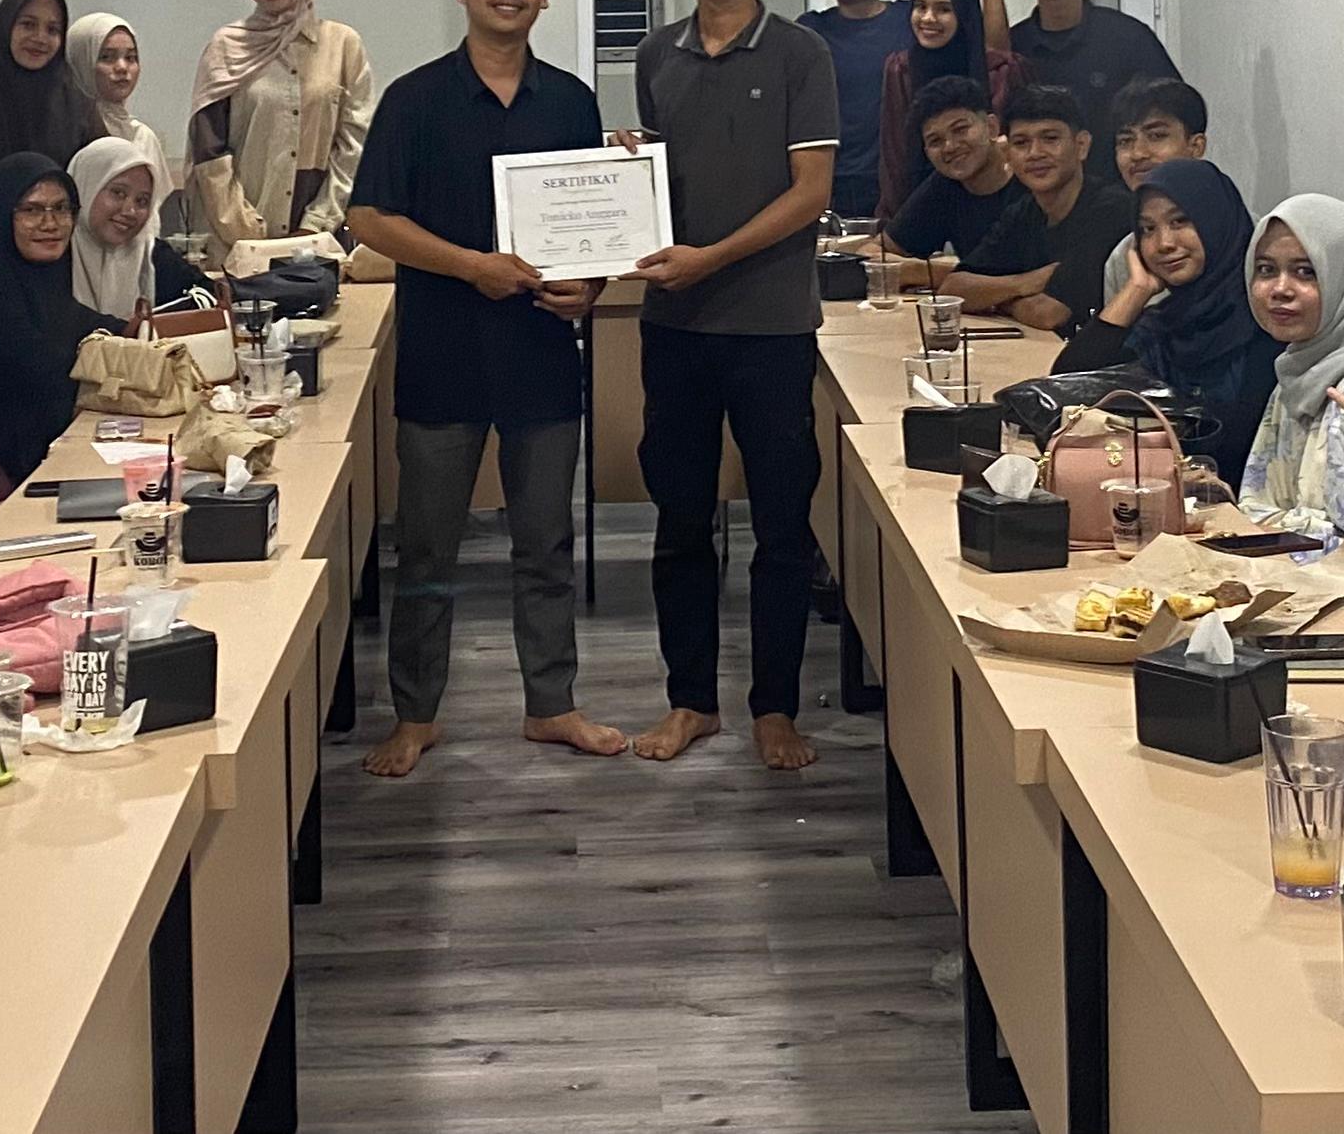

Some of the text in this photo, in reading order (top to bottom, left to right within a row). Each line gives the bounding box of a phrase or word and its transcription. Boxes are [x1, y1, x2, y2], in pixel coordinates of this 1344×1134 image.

[542, 173, 620, 189] SERTIFIKAT
[63, 650, 110, 673] EVERY
[92, 672, 108, 693] IS
